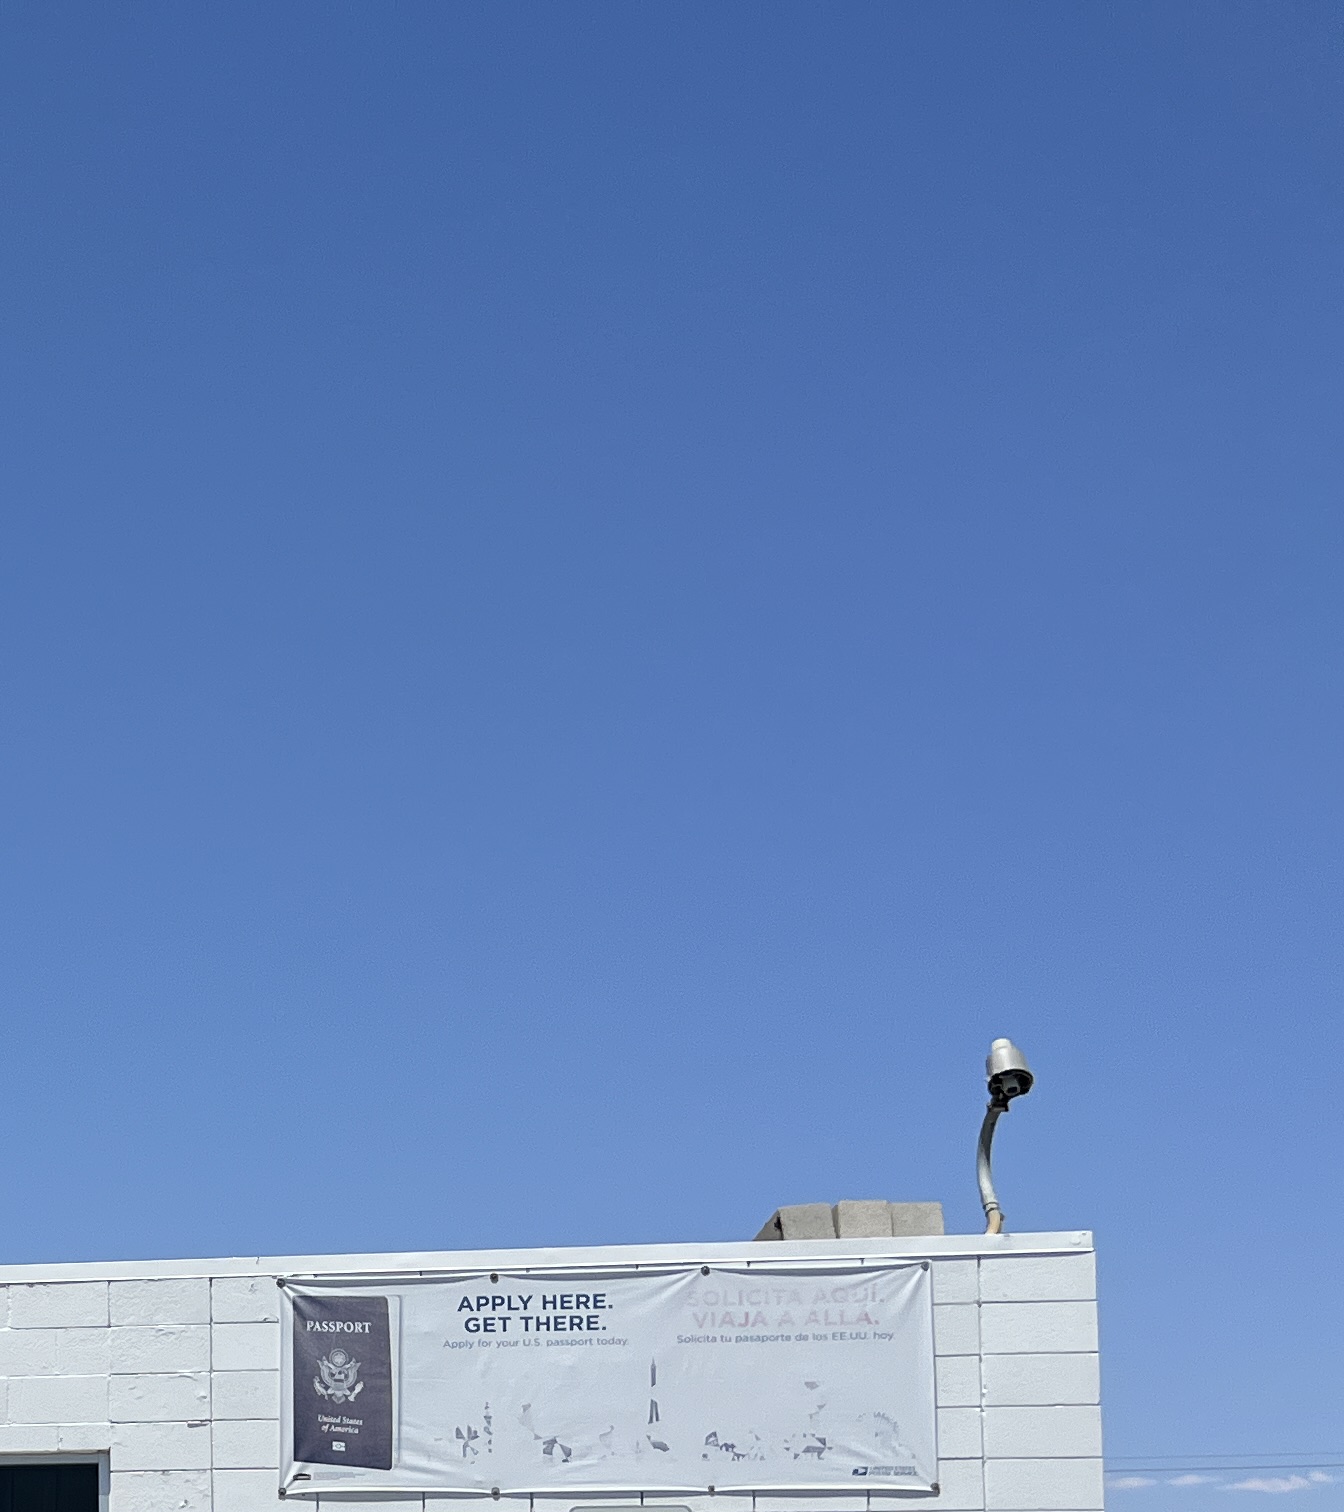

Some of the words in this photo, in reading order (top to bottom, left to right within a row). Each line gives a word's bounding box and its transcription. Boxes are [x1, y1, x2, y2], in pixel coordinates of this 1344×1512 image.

[457, 1295, 533, 1312] APPLY
[542, 1293, 613, 1310] HERE.
[464, 1317, 512, 1333] GET
[520, 1315, 608, 1332] THERE.
[692, 1310, 769, 1329] VIAJA
[306, 1320, 372, 1333] PASSPORT
[443, 1339, 474, 1350] Apply
[477, 1338, 492, 1348] for
[496, 1340, 520, 1349] your
[523, 1338, 543, 1347] U.S.
[547, 1337, 593, 1348] passport
[677, 1333, 717, 1344] Solicita
[720, 1333, 732, 1343] tu
[735, 1333, 792, 1344] pasaporte
[795, 1332, 809, 1342] de
[812, 1332, 829, 1342] los
[318, 1414, 341, 1424] United
[342, 1415, 363, 1426] States
[321, 1423, 329, 1433] of
[329, 1423, 359, 1434] America
